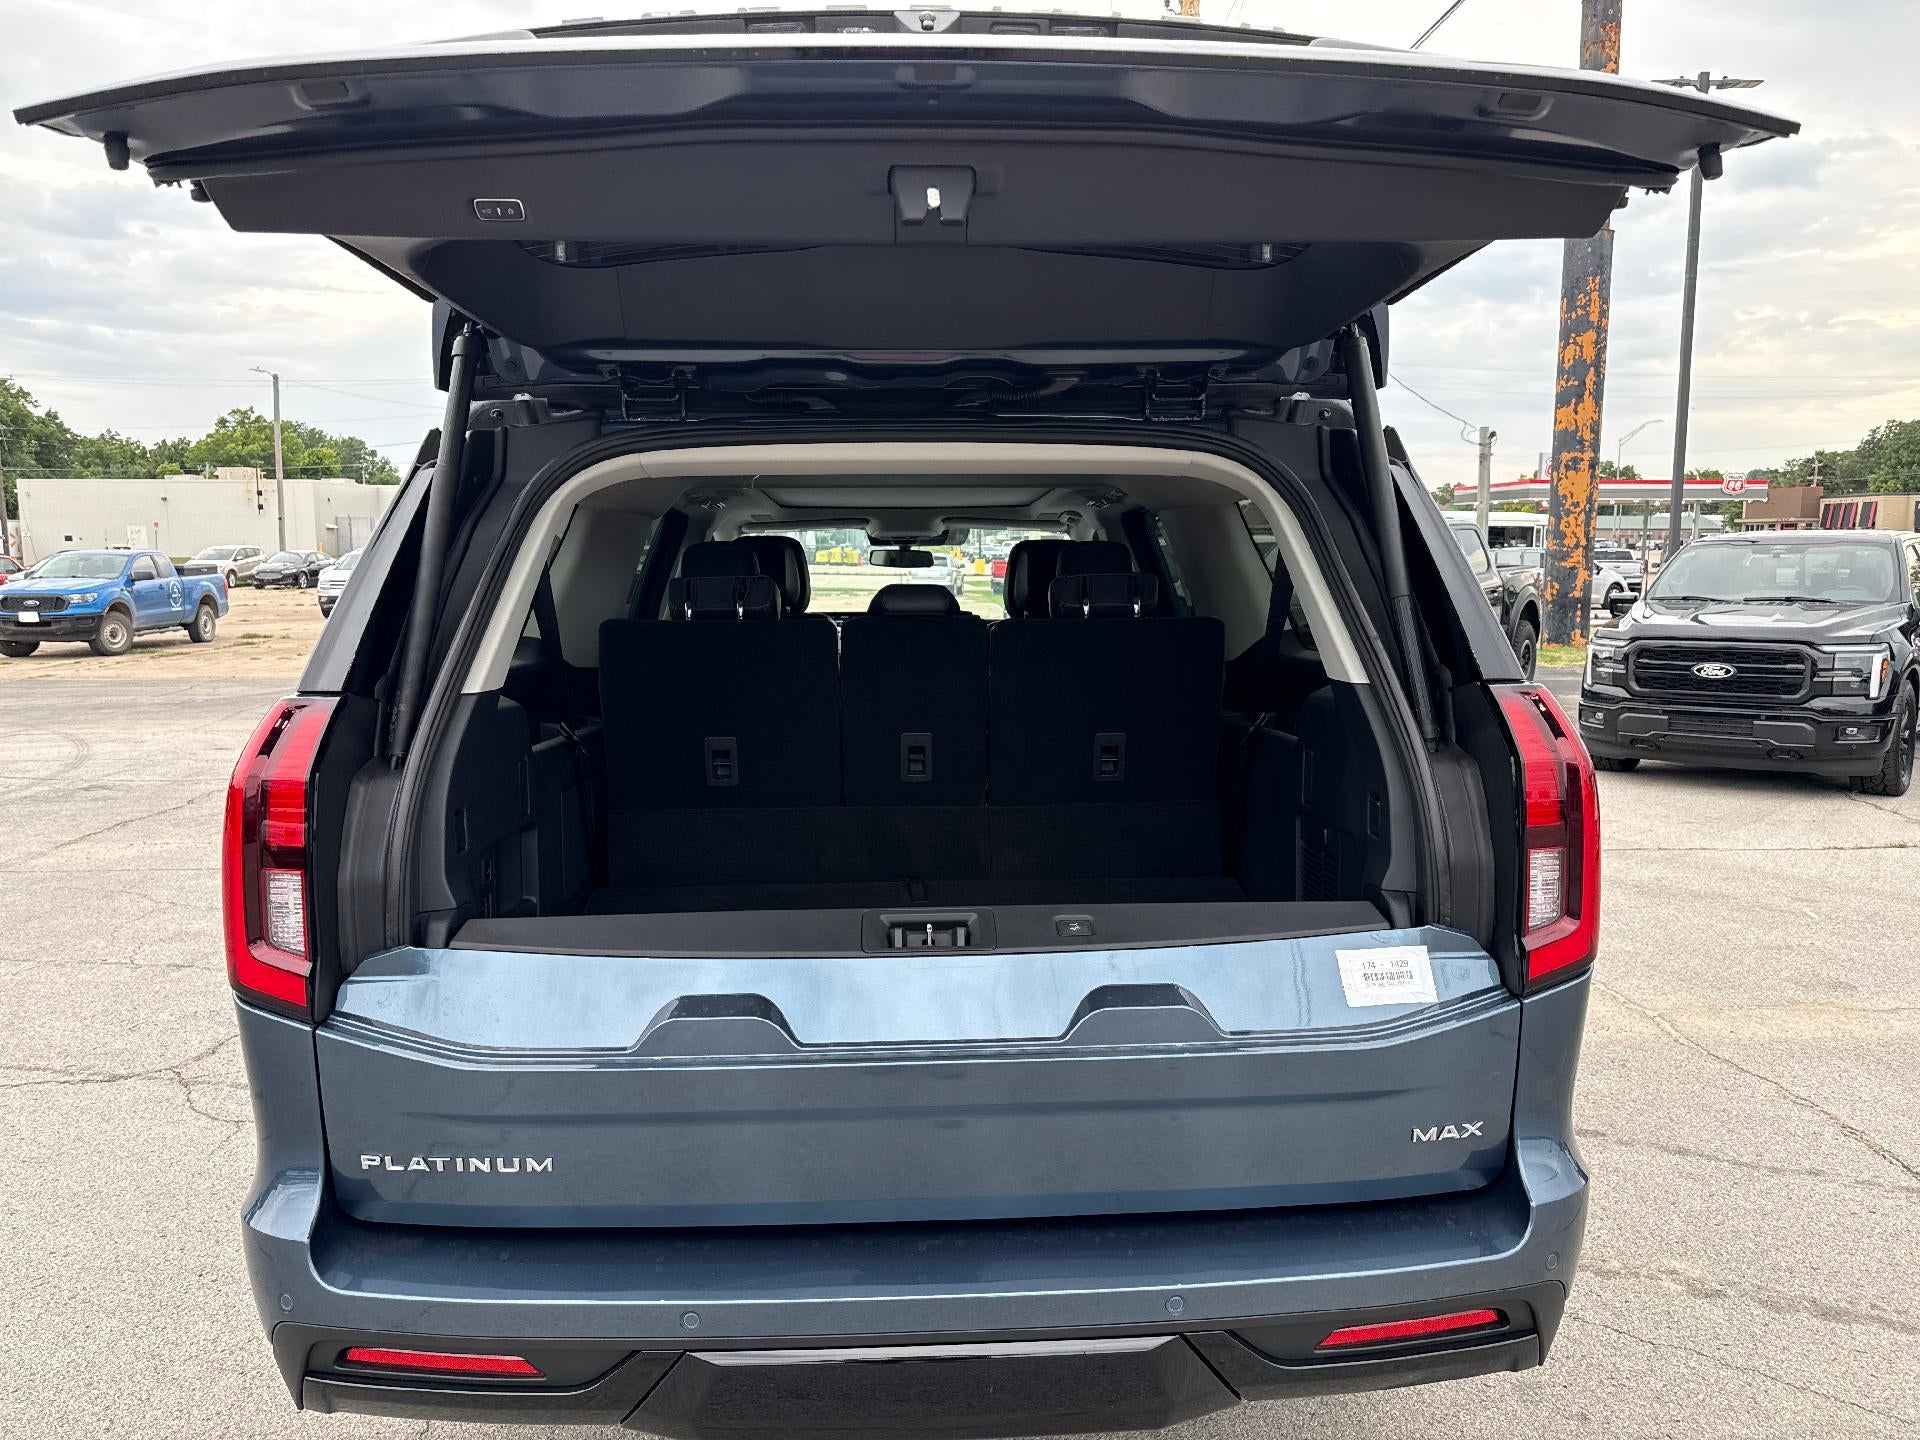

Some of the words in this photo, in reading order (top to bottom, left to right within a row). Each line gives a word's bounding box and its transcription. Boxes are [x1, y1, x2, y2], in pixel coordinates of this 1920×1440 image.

[1727, 480, 1743, 490] 66
[1700, 665, 1727, 676] Ford
[1411, 1120, 1484, 1143] MAX
[360, 1153, 554, 1173] PLATINUM
